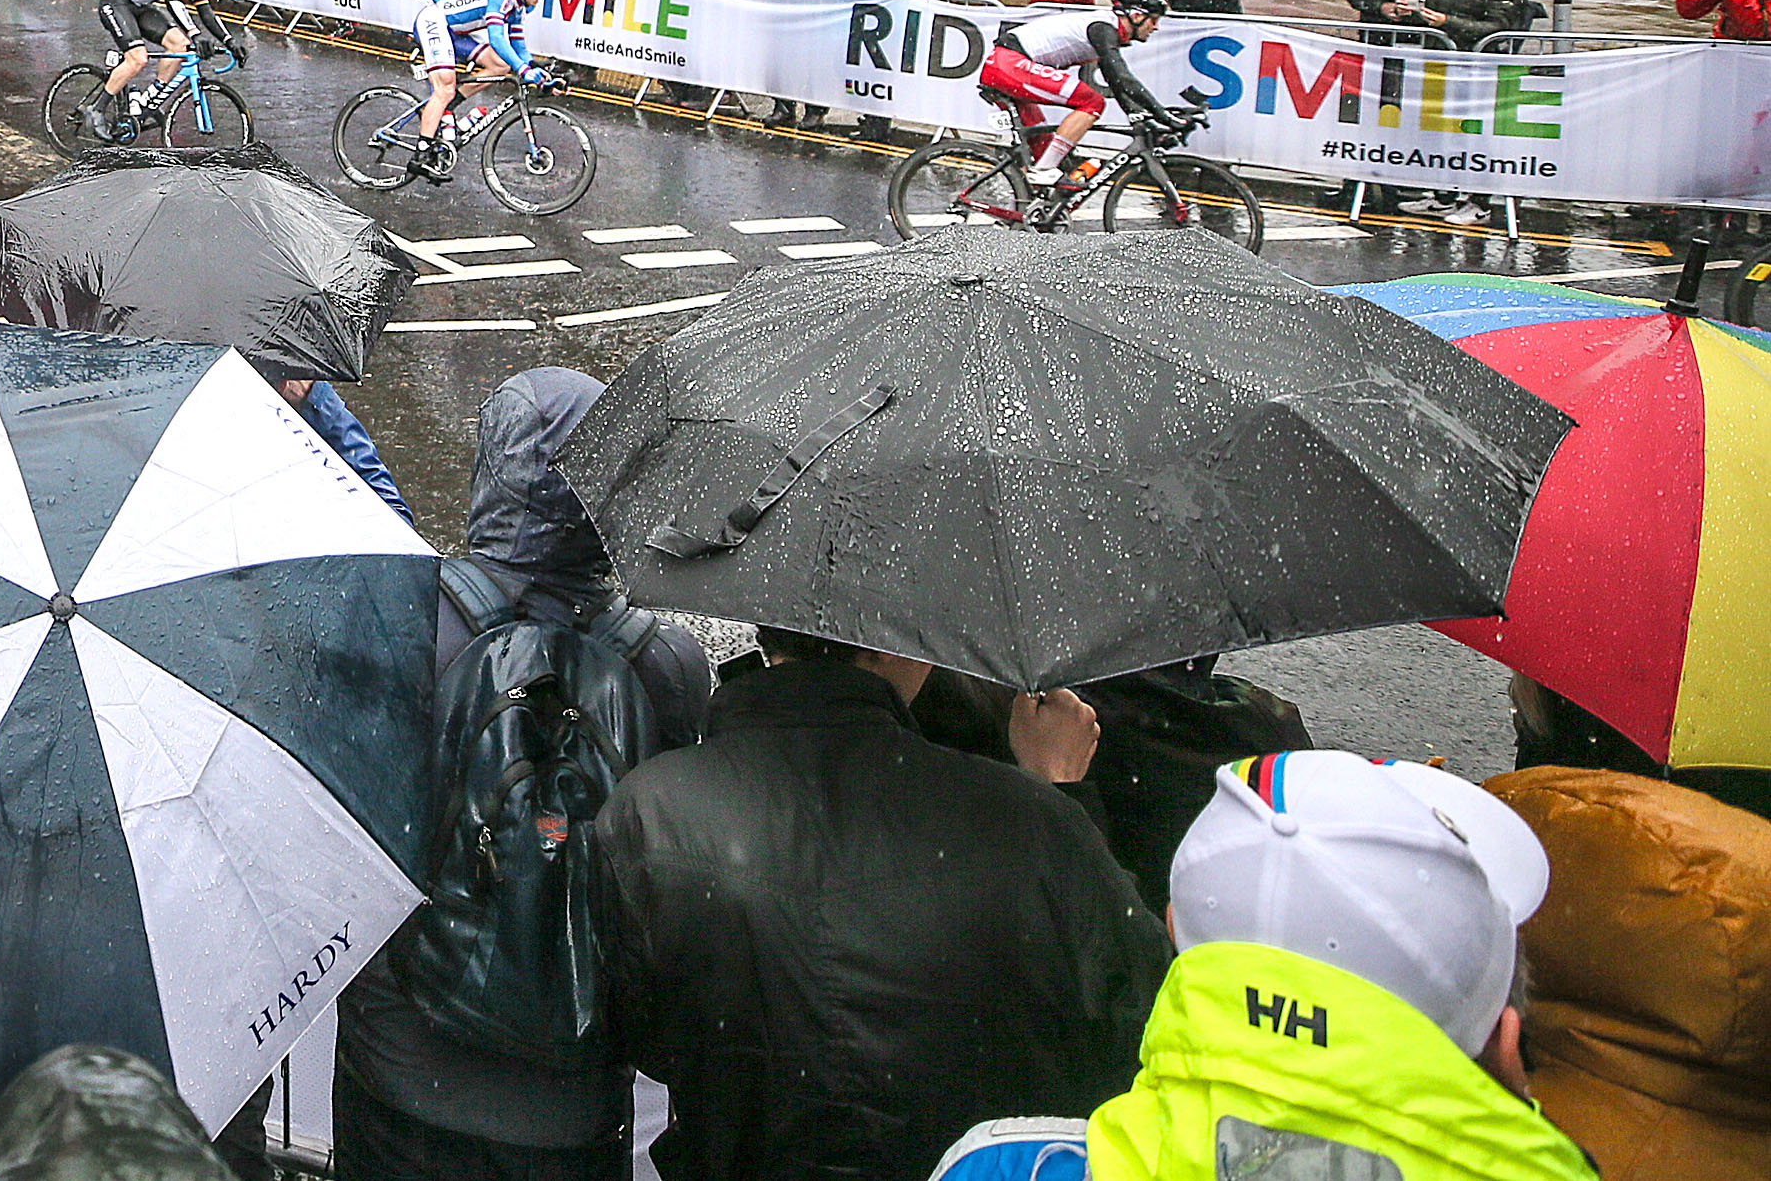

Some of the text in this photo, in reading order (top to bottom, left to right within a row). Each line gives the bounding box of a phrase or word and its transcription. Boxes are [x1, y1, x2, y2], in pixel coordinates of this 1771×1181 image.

[574, 36, 687, 68] #RideAndSmile
[147, 74, 188, 111] CANYON
[854, 80, 893, 101] UCI
[1188, 36, 1566, 140] SMILE
[461, 96, 516, 145] S-WORKS
[1322, 140, 1559, 178] #RideAndSmile
[265, 403, 360, 494] HARDY
[248, 920, 353, 1048] HARDY
[1245, 985, 1328, 1049] HH
